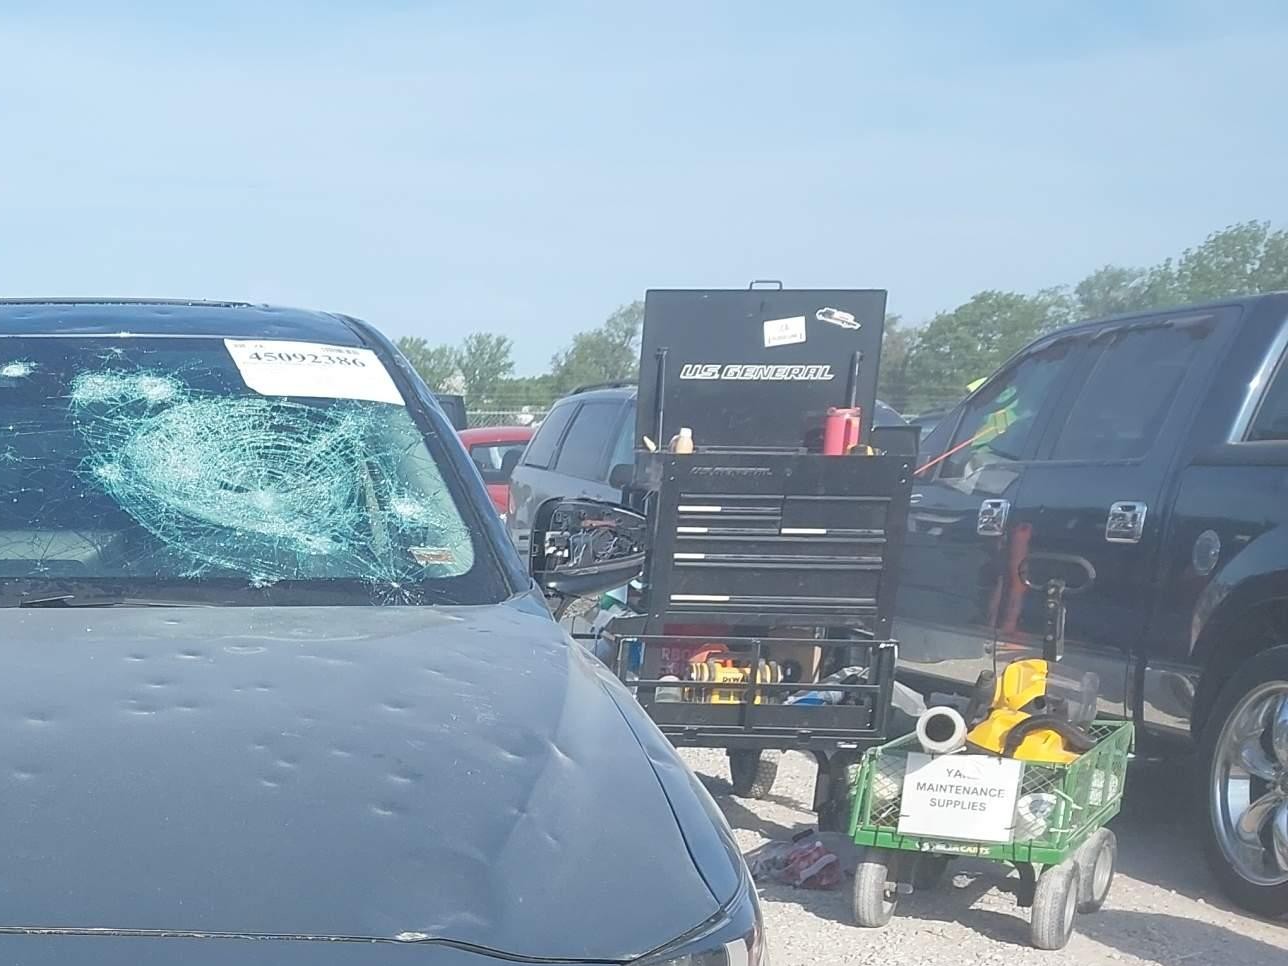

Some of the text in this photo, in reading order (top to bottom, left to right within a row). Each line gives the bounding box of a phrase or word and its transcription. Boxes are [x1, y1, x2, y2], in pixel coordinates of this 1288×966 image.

[249, 351, 366, 368] 45092386
[721, 364, 835, 380] GENERAL
[916, 782, 1006, 799] MAINTENANCE
[929, 797, 987, 812] SUPPLIES
